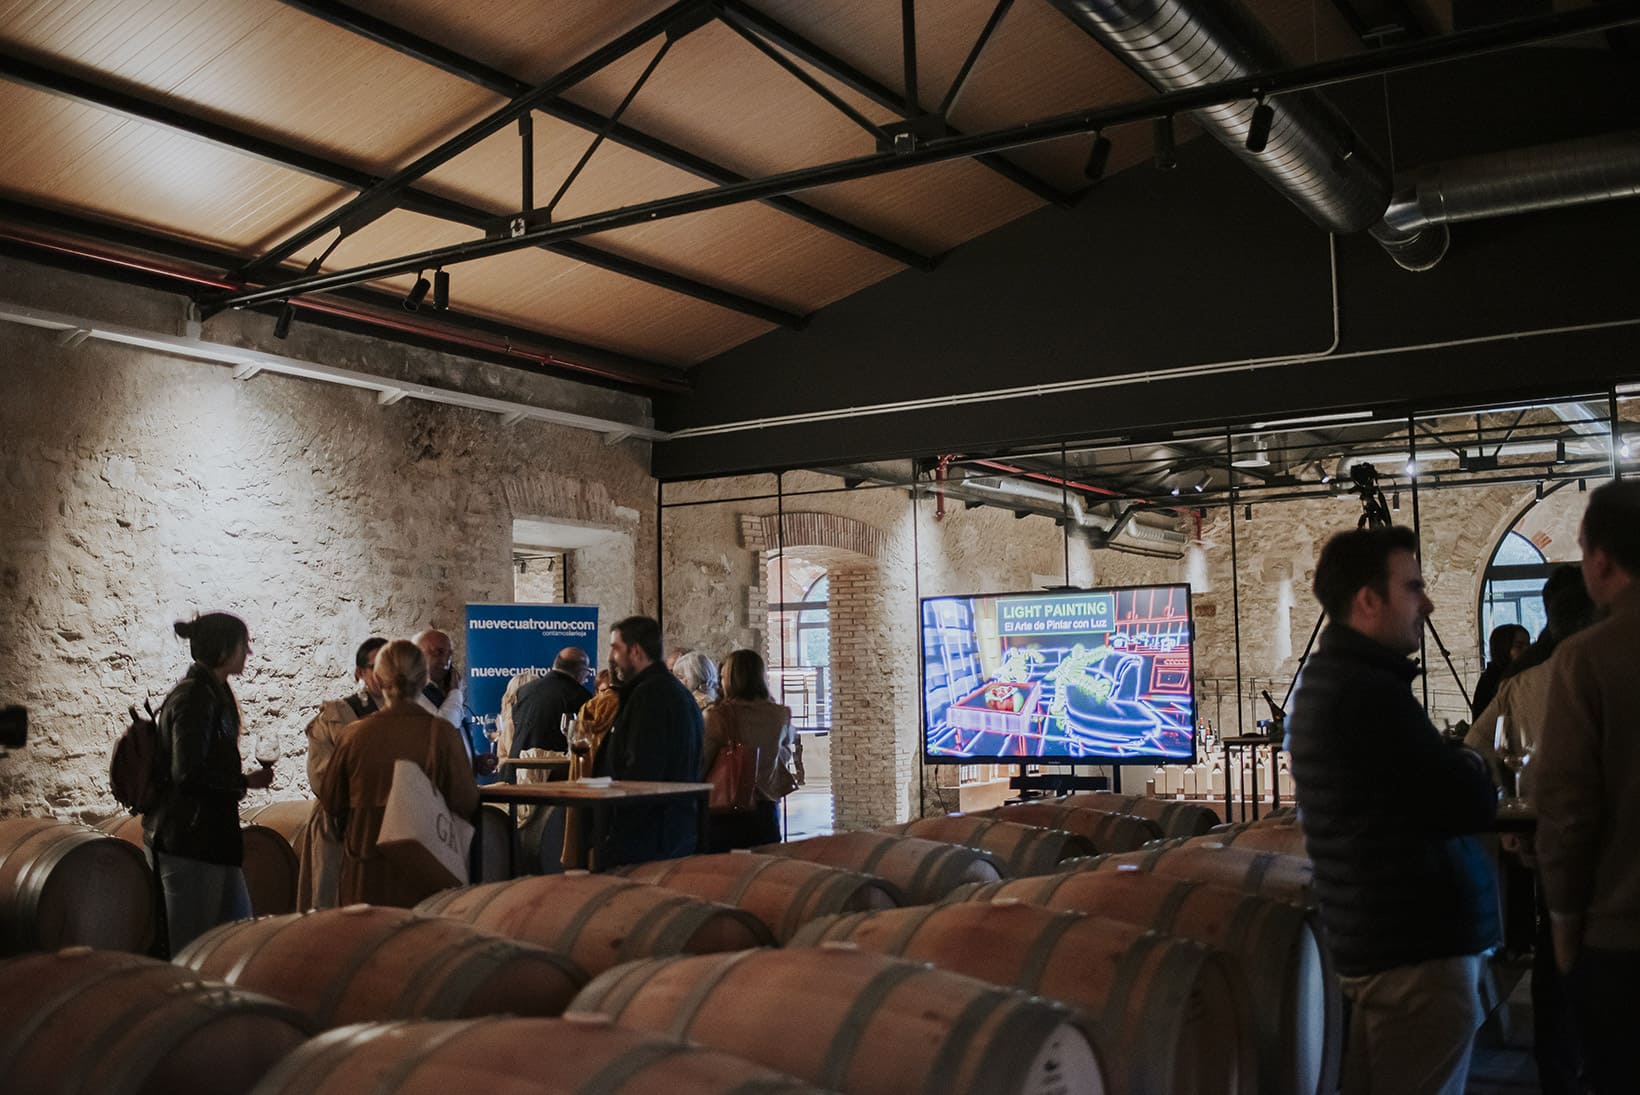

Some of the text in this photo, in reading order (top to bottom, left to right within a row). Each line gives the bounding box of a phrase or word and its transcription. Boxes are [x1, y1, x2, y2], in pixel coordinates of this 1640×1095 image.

[1003, 602, 1107, 619] LIGHT PAINTING
[1004, 618, 1107, 632] El Arte de Pintar con Luz
